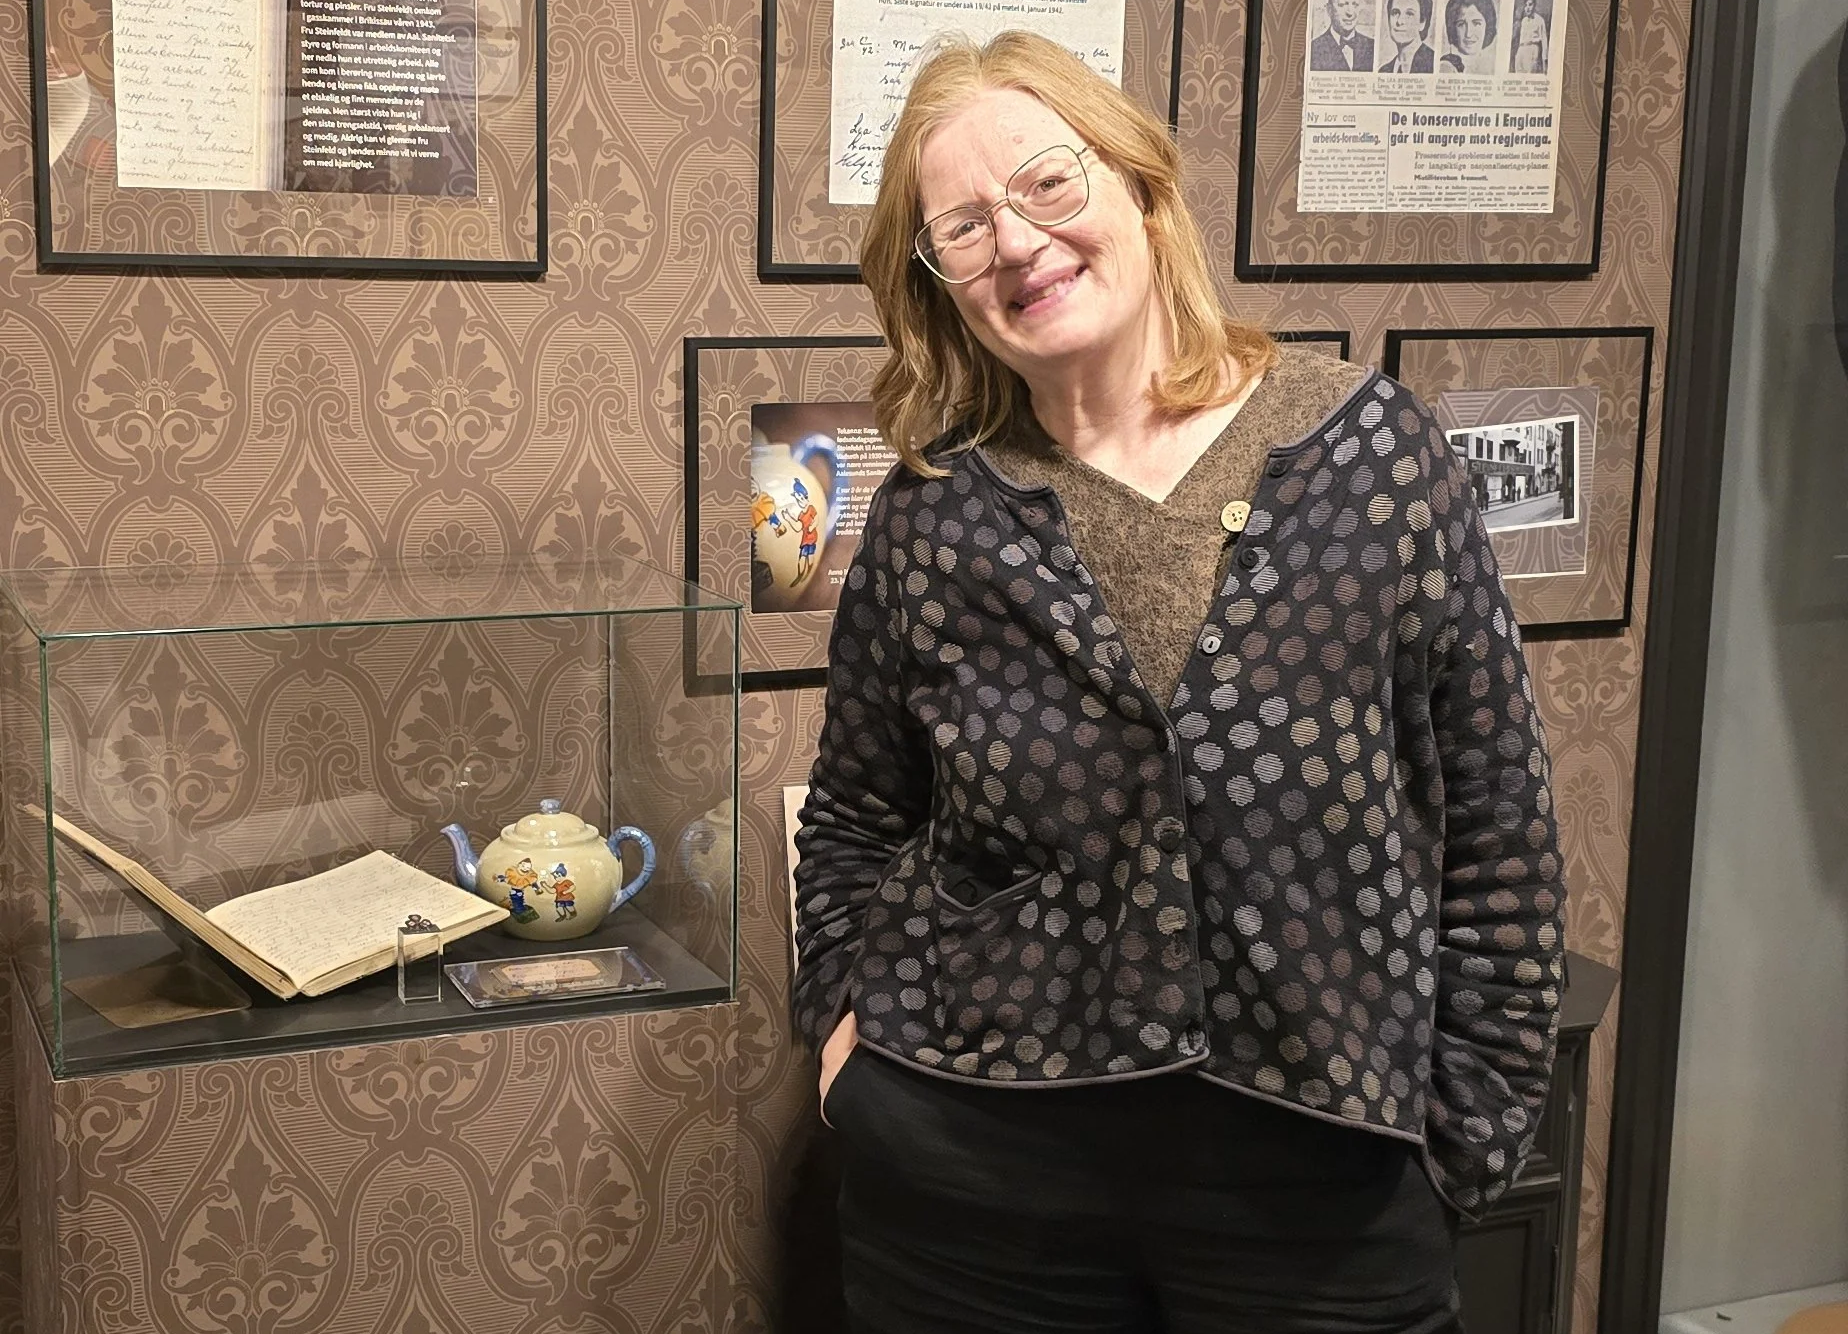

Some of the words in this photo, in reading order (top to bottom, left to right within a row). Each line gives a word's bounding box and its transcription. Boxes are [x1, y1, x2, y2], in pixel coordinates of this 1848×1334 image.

[1307, 111, 1320, 123] Ny
[1324, 112, 1338, 122] lov
[1342, 114, 1356, 123] om
[1391, 111, 1407, 126] De
[1412, 111, 1491, 127] konservative
[1502, 113, 1552, 131] England
[1390, 130, 1409, 147] går
[1412, 131, 1424, 144] til
[1427, 134, 1466, 147] angrep
[1469, 133, 1491, 145] mot
[1493, 132, 1551, 148] regjeringa.
